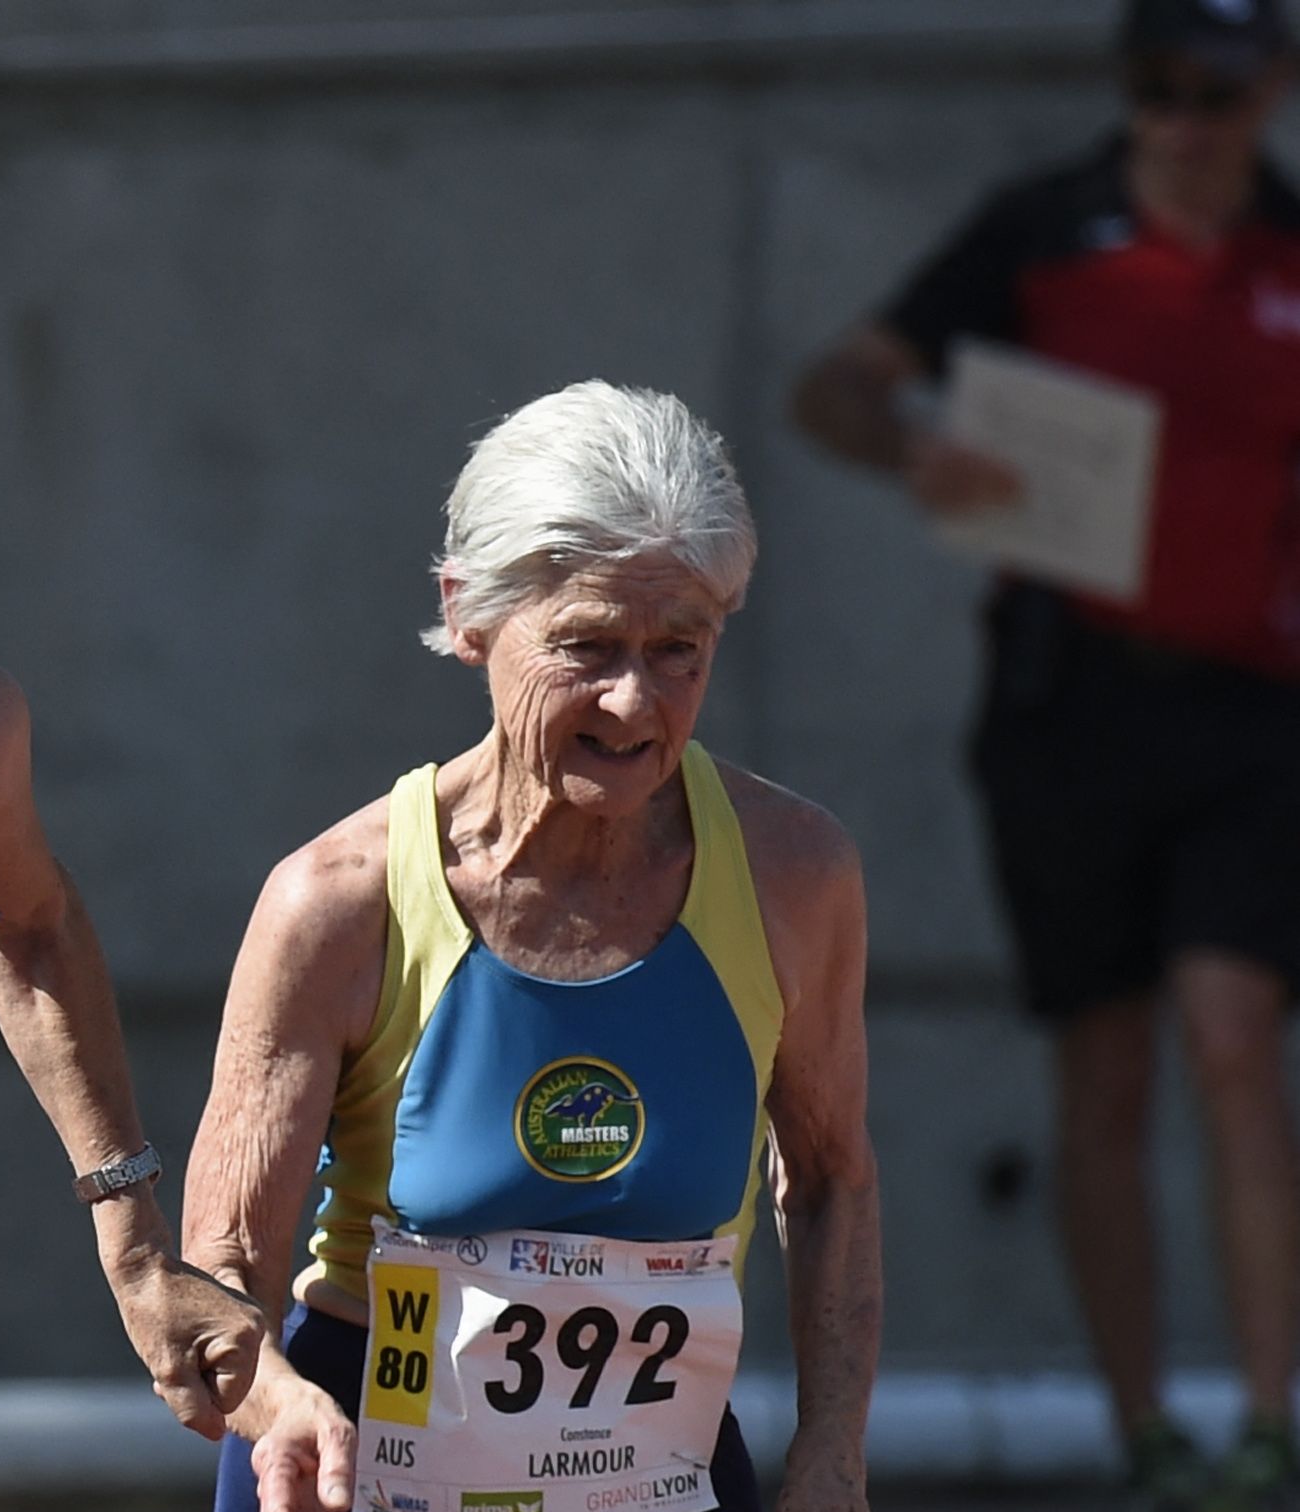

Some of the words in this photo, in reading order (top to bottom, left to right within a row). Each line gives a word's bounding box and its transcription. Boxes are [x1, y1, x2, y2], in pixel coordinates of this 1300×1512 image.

[561, 1125, 630, 1144] MASTERS
[549, 1257, 604, 1278] LYON
[386, 1288, 431, 1336] W
[375, 1346, 429, 1395] 80
[483, 1302, 690, 1415] 392
[559, 1426, 613, 1443] Constance
[374, 1436, 416, 1468] AUS
[528, 1444, 636, 1479] LARMOUR
